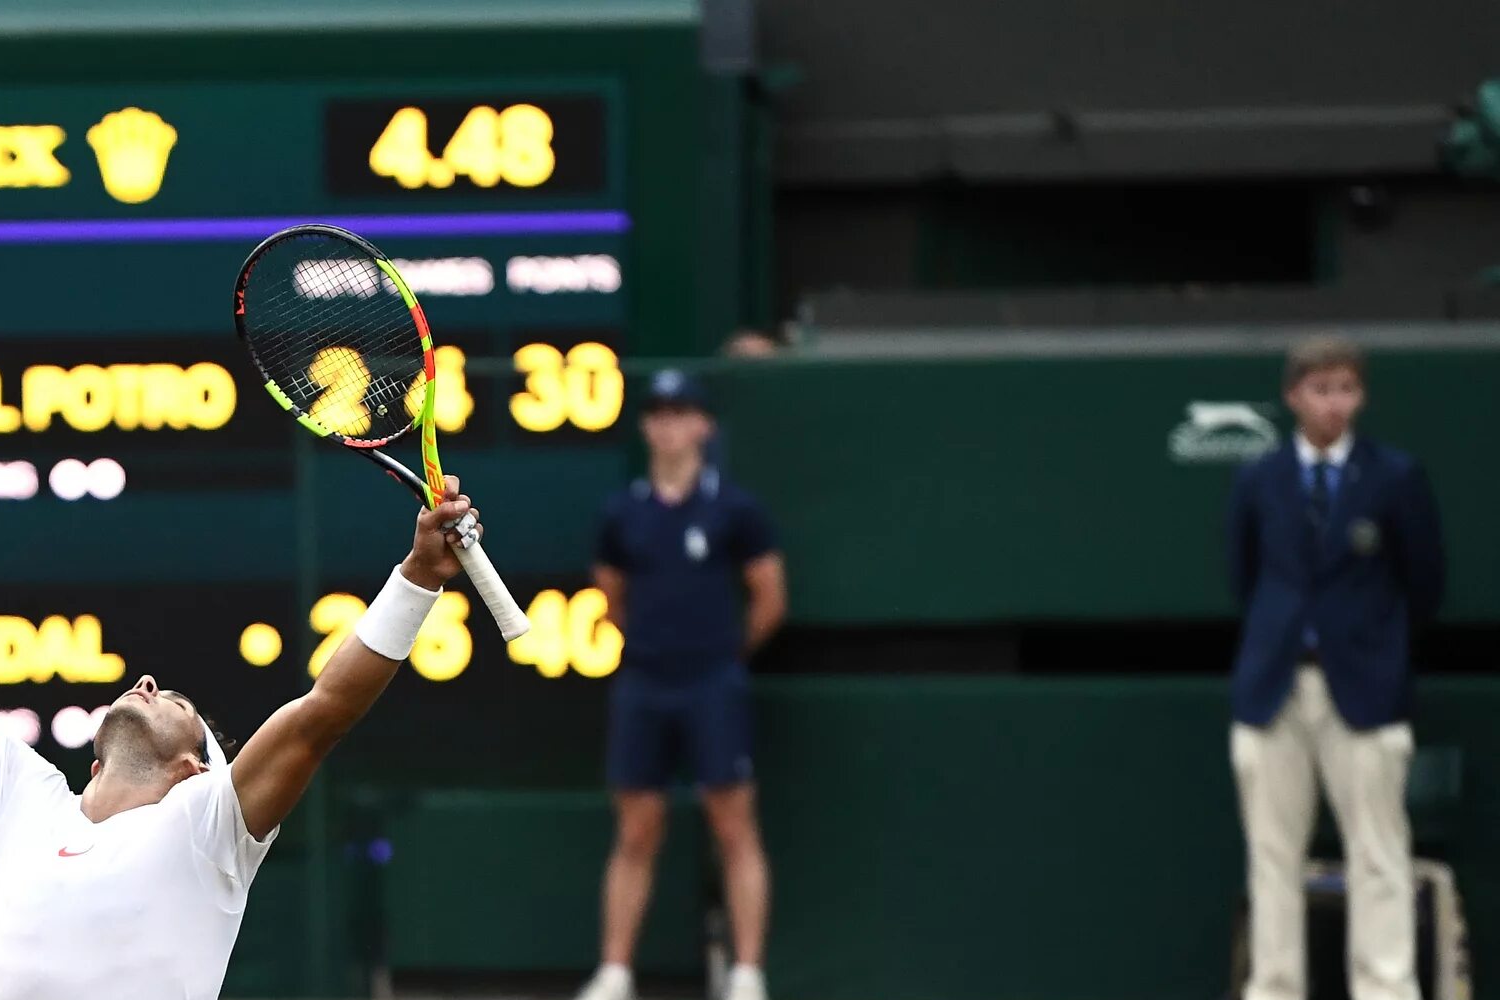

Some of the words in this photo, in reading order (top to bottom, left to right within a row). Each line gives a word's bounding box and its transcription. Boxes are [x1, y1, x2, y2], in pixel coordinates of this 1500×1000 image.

[368, 103, 556, 188] 4.48
[22, 362, 237, 431] POTRO
[307, 346, 371, 436] 2
[509, 342, 625, 432] 30
[409, 591, 473, 681] 6
